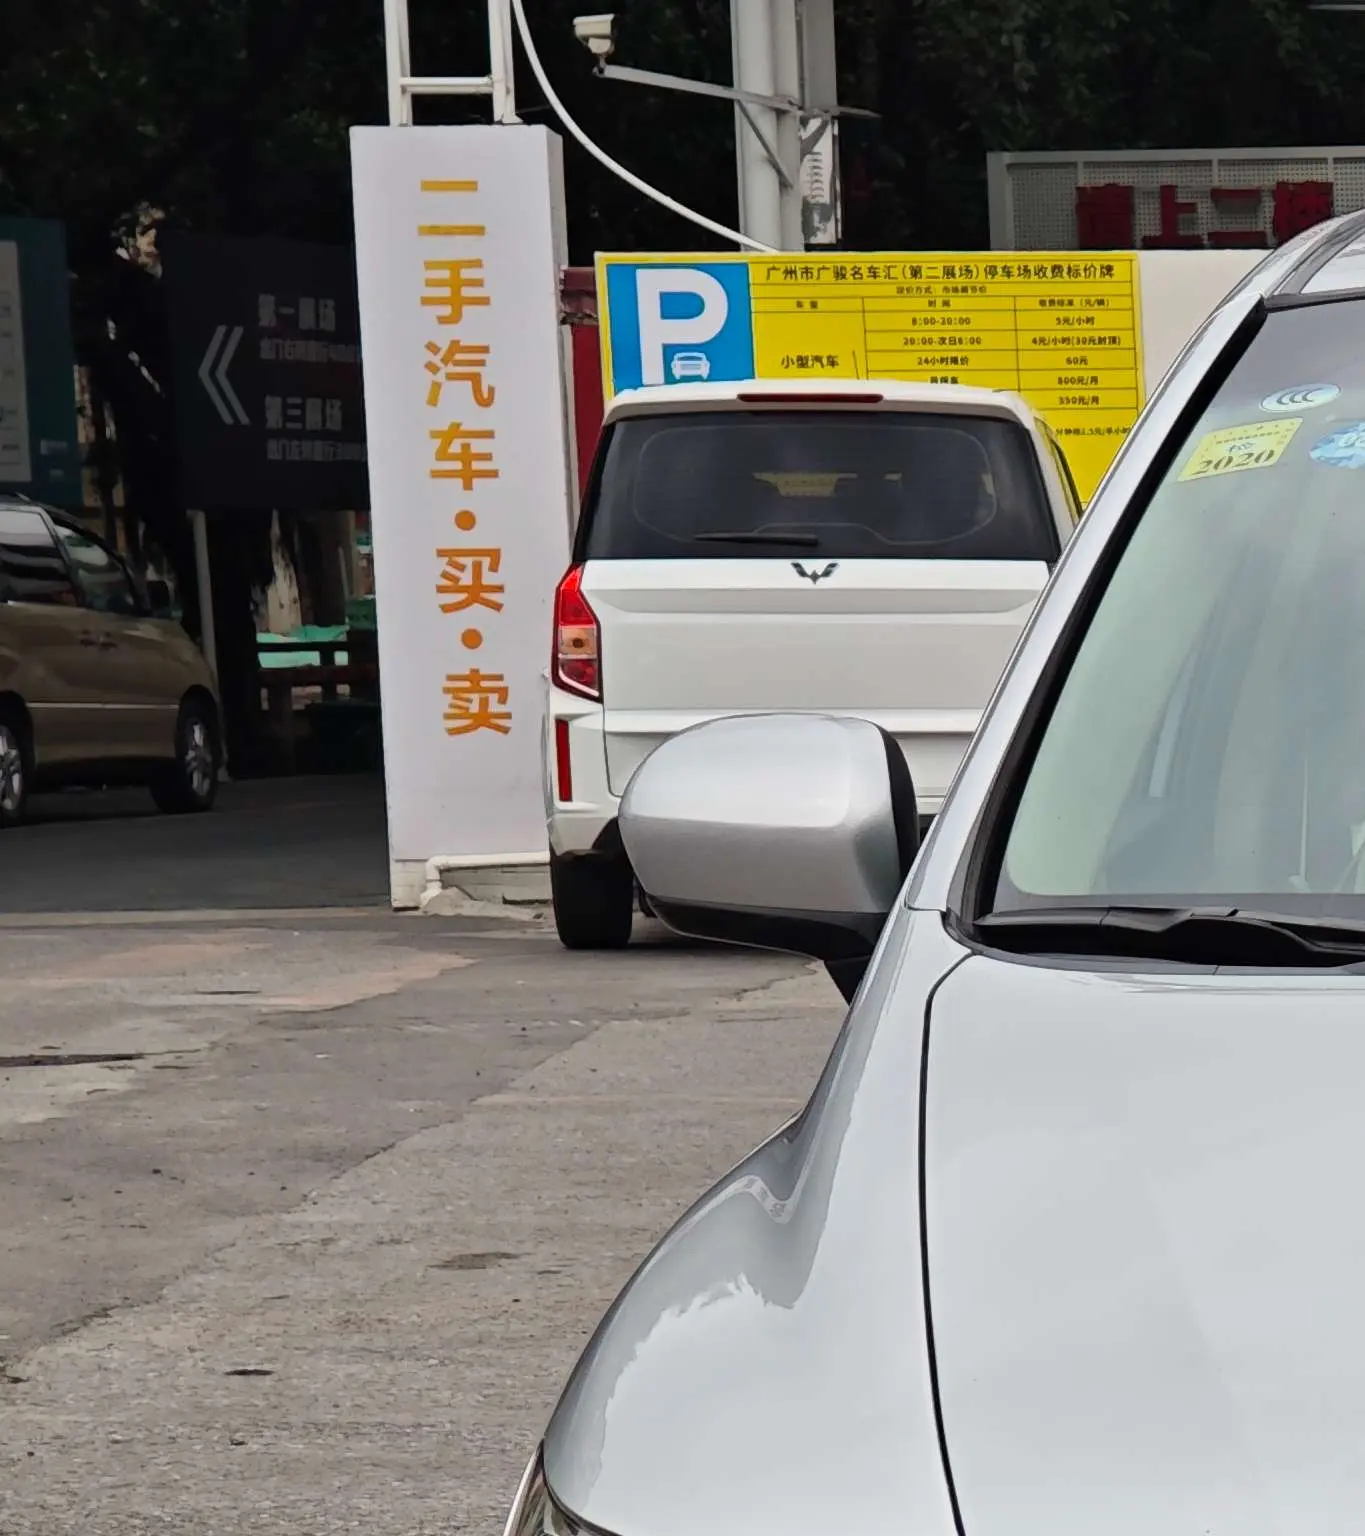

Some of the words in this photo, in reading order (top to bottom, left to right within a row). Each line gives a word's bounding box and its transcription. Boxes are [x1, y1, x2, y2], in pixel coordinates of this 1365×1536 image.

[636, 269, 728, 385] P
[781, 354, 840, 369] 小型汽车
[1191, 449, 1276, 476] 2020
